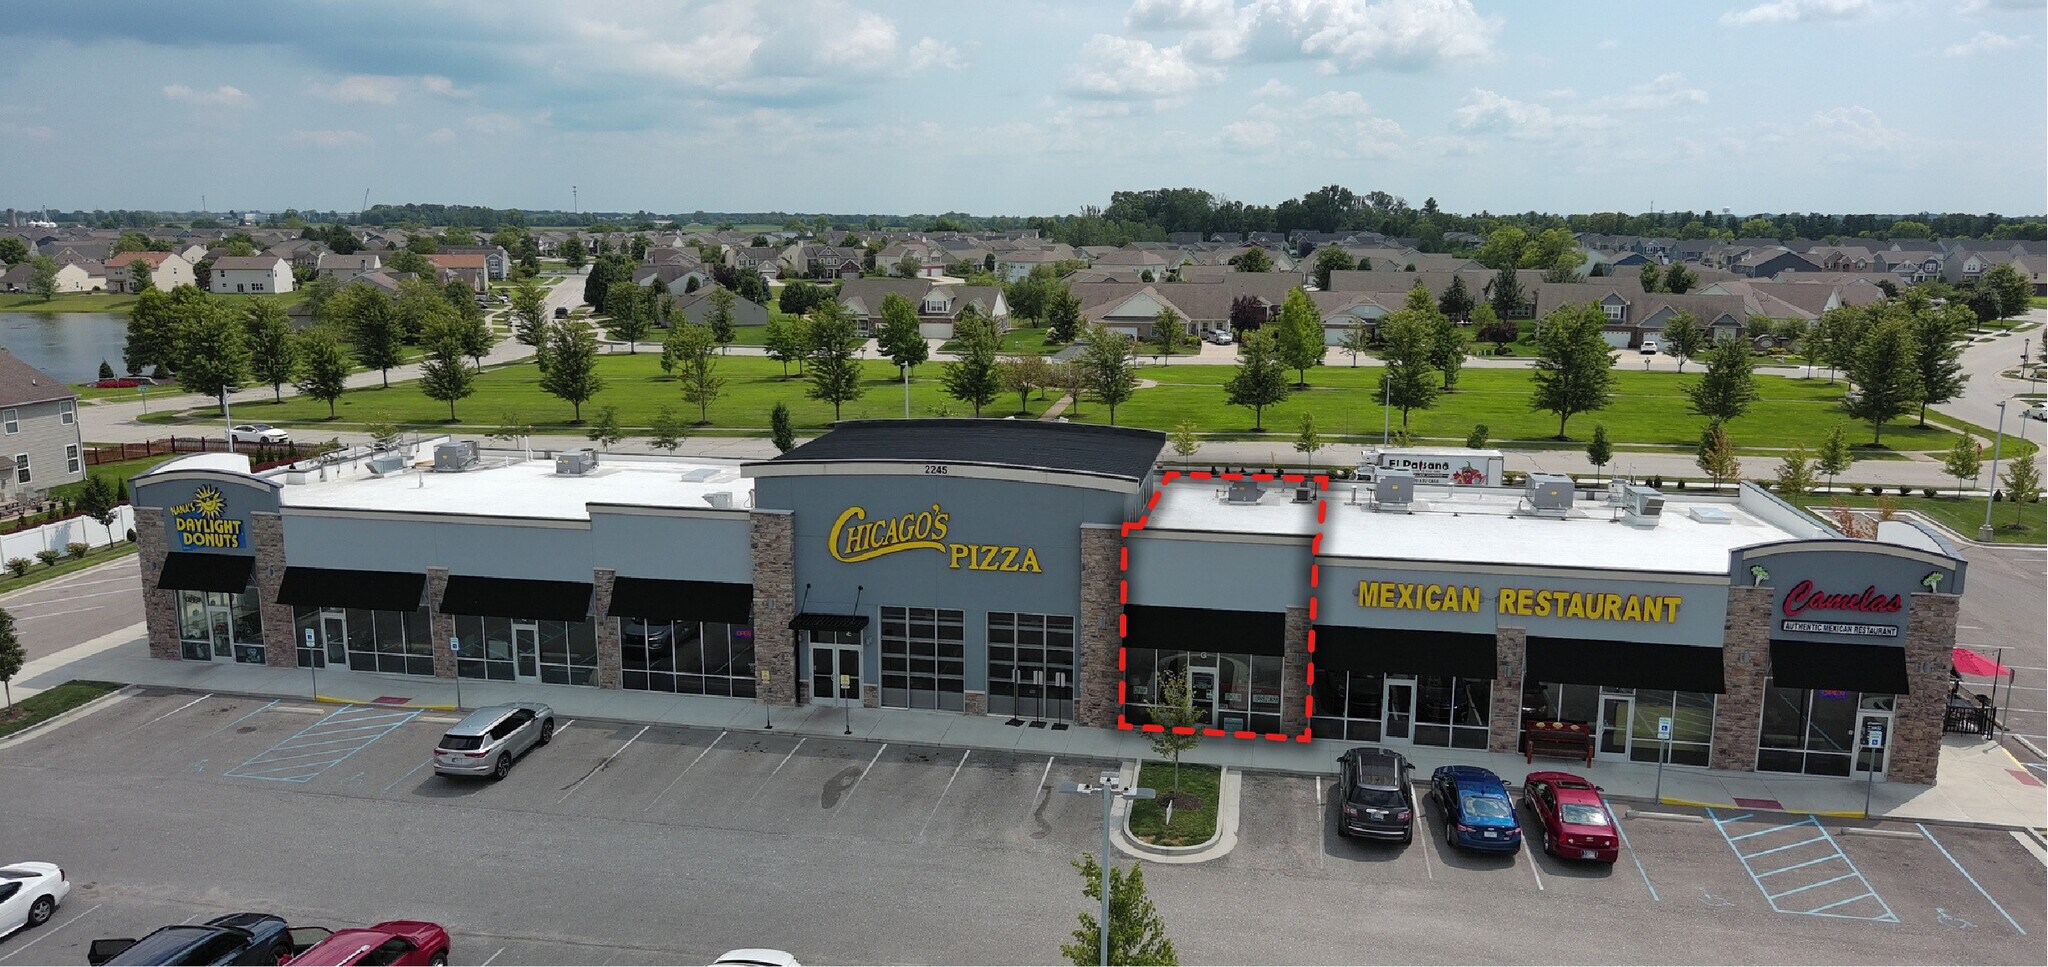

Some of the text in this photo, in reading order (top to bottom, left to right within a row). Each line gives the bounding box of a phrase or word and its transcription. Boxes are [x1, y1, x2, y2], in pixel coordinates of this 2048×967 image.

[925, 465, 948, 475] 2245
[176, 517, 242, 534] DAYLIGHT
[183, 532, 239, 548] DONUTS
[949, 543, 1042, 573] PIZZA
[1358, 580, 1682, 623] MEXICAN RESTAURANT
[1785, 621, 1897, 636] AUTHENTIC MEXICAN RESTAURANT
